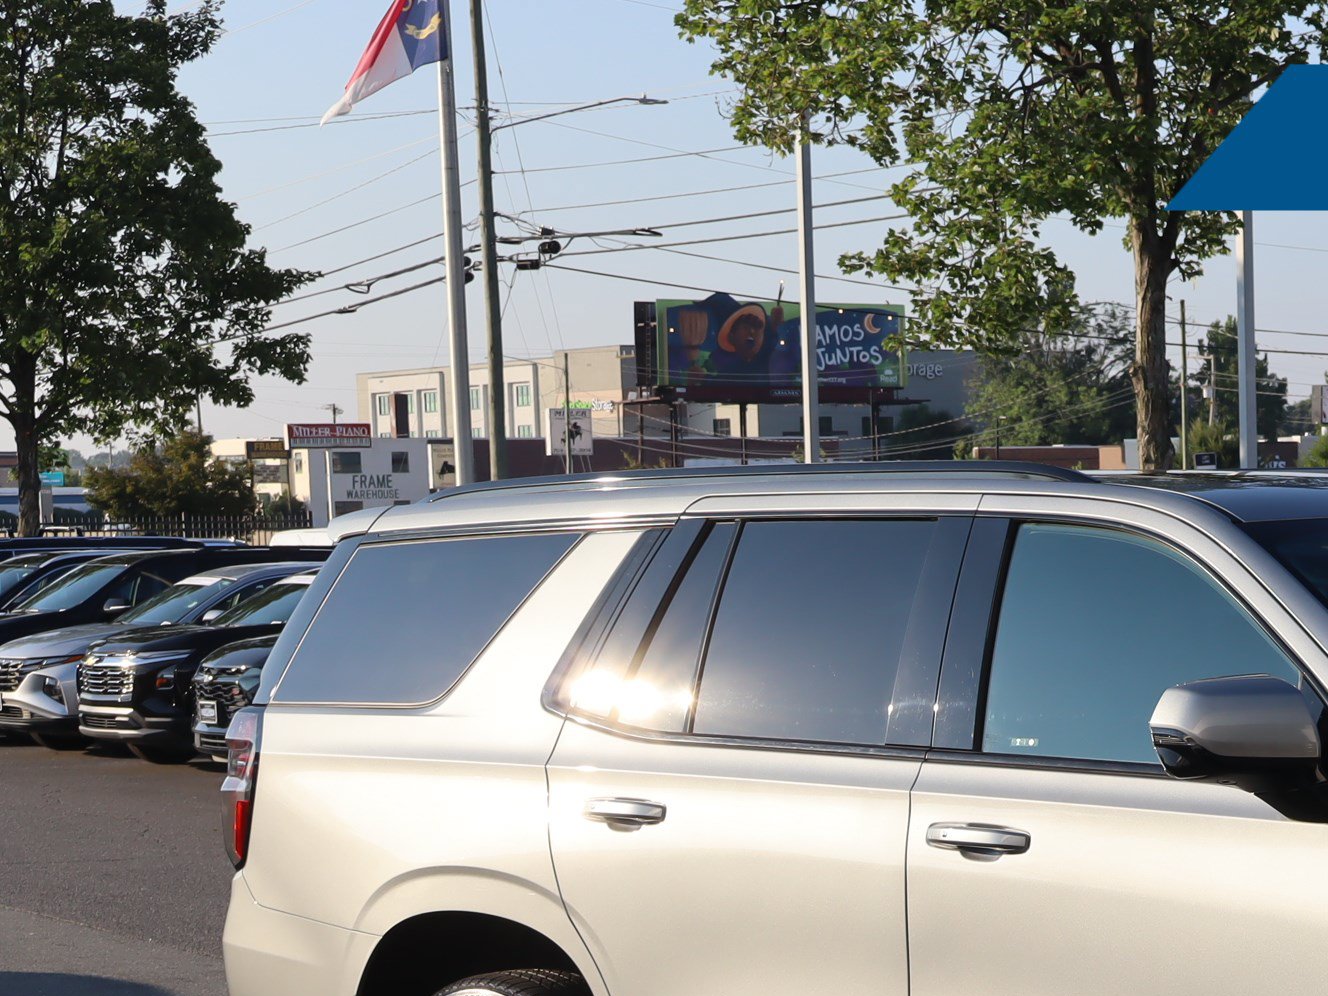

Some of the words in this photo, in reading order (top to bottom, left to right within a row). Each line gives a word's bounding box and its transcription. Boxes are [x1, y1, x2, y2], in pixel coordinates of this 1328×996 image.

[800, 323, 865, 346] AMOS
[352, 474, 393, 489] FRAME
[346, 488, 399, 500] WAREHOUSE
